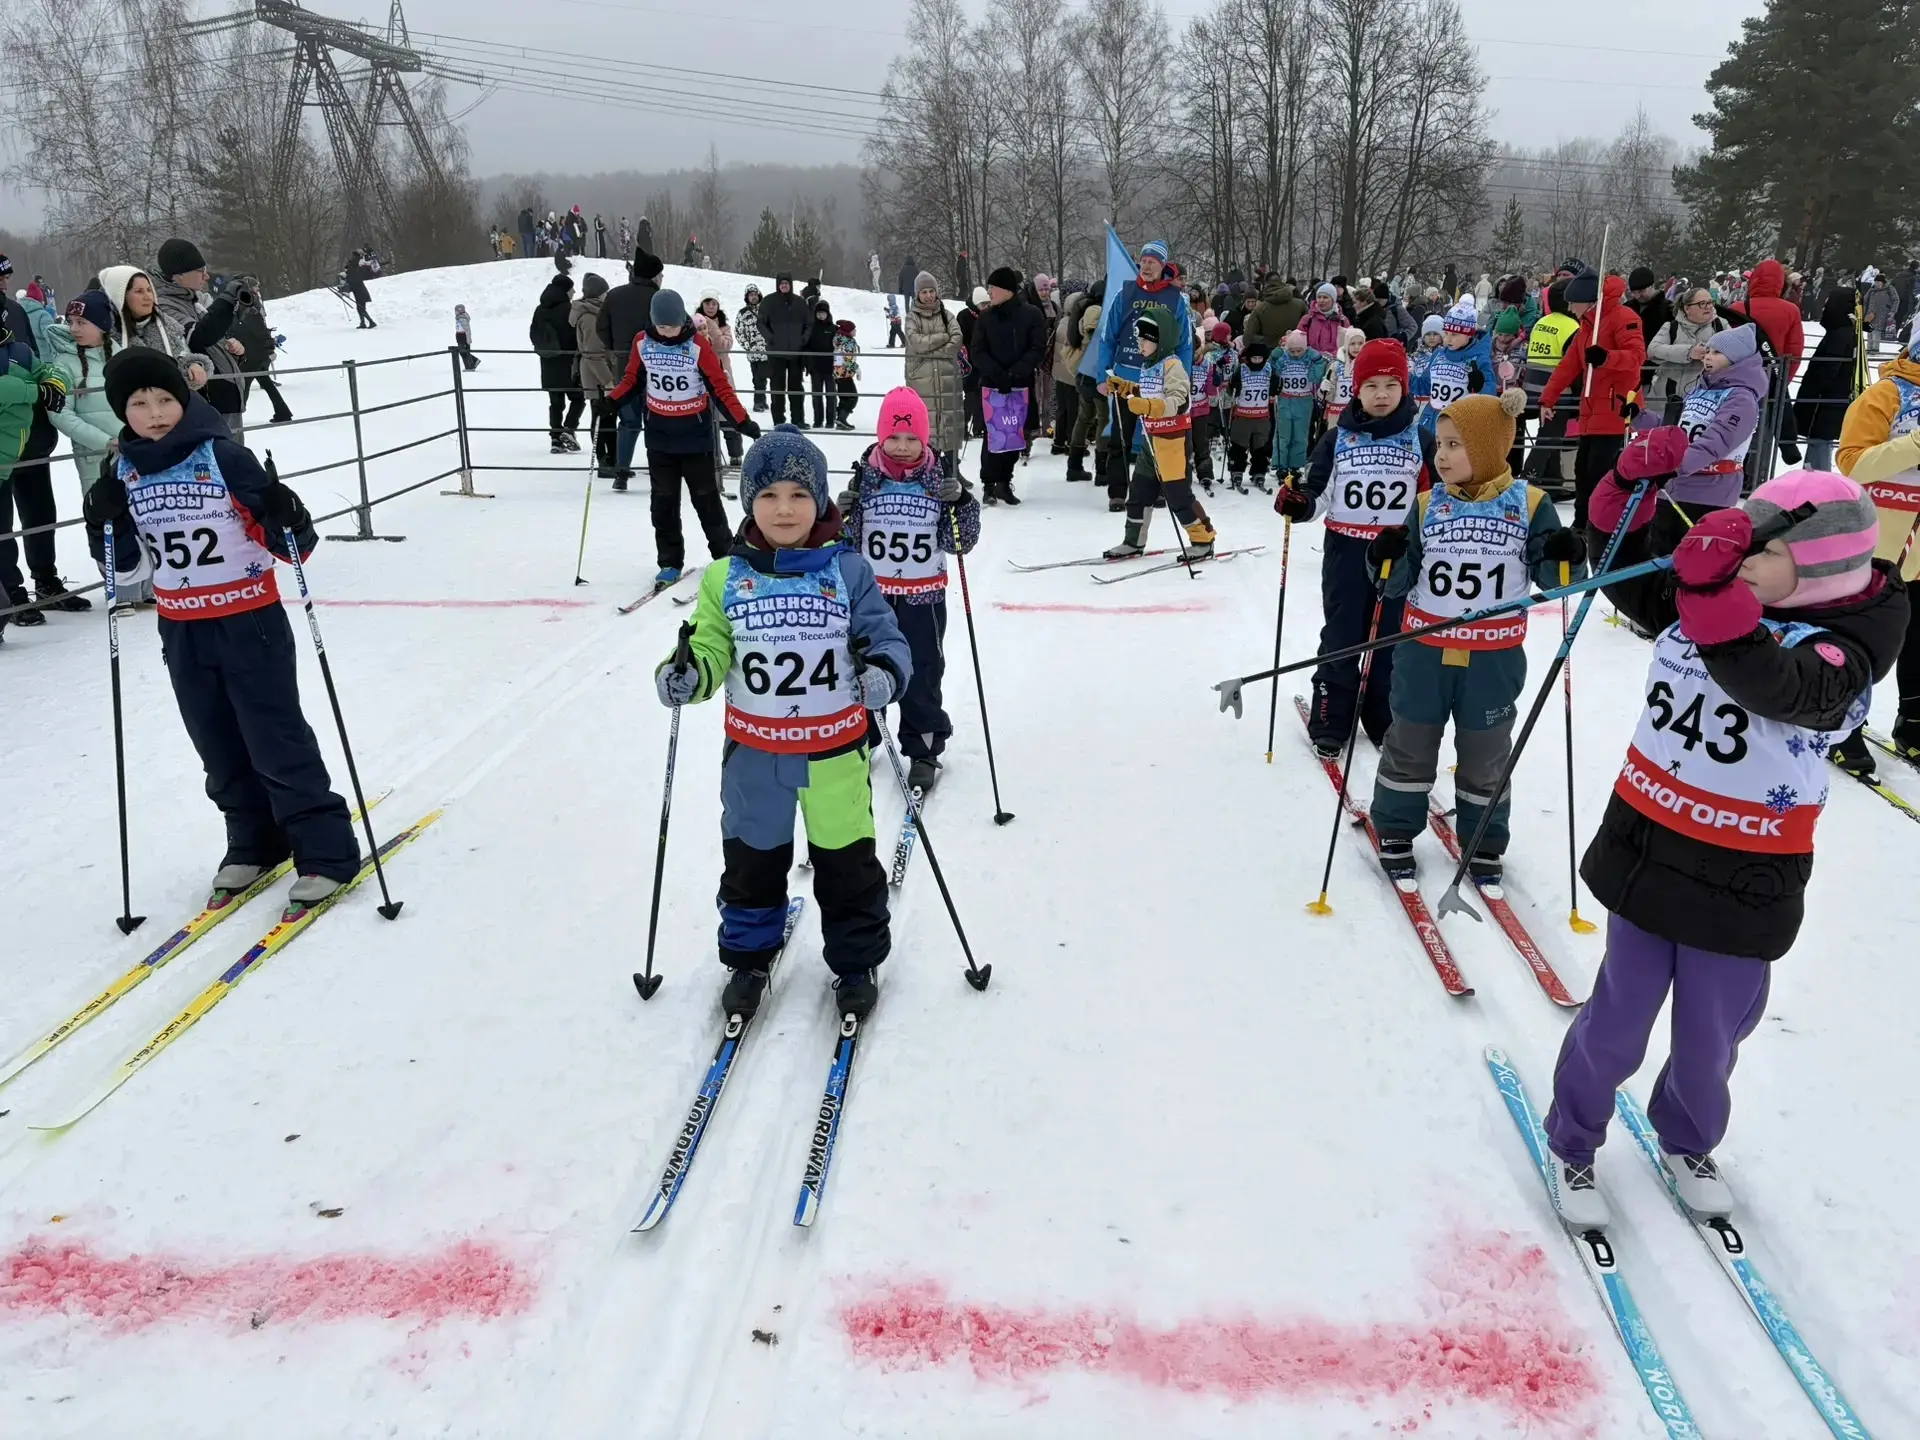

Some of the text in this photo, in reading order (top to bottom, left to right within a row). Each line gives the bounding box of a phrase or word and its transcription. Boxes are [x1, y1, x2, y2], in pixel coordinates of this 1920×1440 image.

[1534, 323, 1559, 335] TEWARD
[650, 373, 689, 392] 566
[1191, 384, 1205, 396] 94
[1284, 377, 1307, 389] 589
[1340, 385, 1353, 398] 39
[1244, 389, 1268, 401] 576
[1431, 383, 1465, 403] 592
[1002, 415, 1018, 425] WB
[1680, 421, 1706, 443] 56
[1336, 446, 1420, 463] КРЕЩЕНСКИЕ
[1352, 455, 1405, 466] МОРОЗЫ
[1360, 468, 1383, 476] Сергея
[128, 483, 224, 505] РЕЩЕНСКИЕ
[1344, 480, 1407, 510] 662
[136, 495, 203, 515] МОРОЗЫ
[875, 504, 927, 517] МОРОЗЫ
[146, 515, 176, 527] Сергея
[177, 511, 224, 523] Веселова
[883, 518, 905, 527] Сергея
[1423, 517, 1527, 540] КРЕЩЕНСКИЕ
[868, 530, 932, 563] 655
[1439, 529, 1507, 545] МОРОЗЫ
[149, 527, 225, 571] 652
[1449, 546, 1478, 557] Сергея
[104, 541, 115, 593] NORDWAY
[1428, 560, 1506, 600] 651
[155, 581, 268, 611] АСНОГОРСК
[726, 596, 849, 620] КРЕЩЕНСКИЕ
[747, 610, 826, 629] МОРОЗЫ
[762, 633, 796, 645] Сергея
[799, 629, 846, 642] Веселова
[742, 648, 840, 697] 624
[671, 705, 681, 740] ORDWAY
[728, 707, 864, 741] КРАСНОГОРСК
[1647, 680, 1750, 764] 643
[1621, 762, 1785, 837] АСНОГОРСК
[45, 992, 110, 1043] FISCHER
[1495, 1067, 1516, 1084] XC
[660, 1093, 712, 1201] NORDWAY
[803, 1092, 840, 1197] NORDWAY
[1550, 1162, 1563, 1211] NORDWAY
